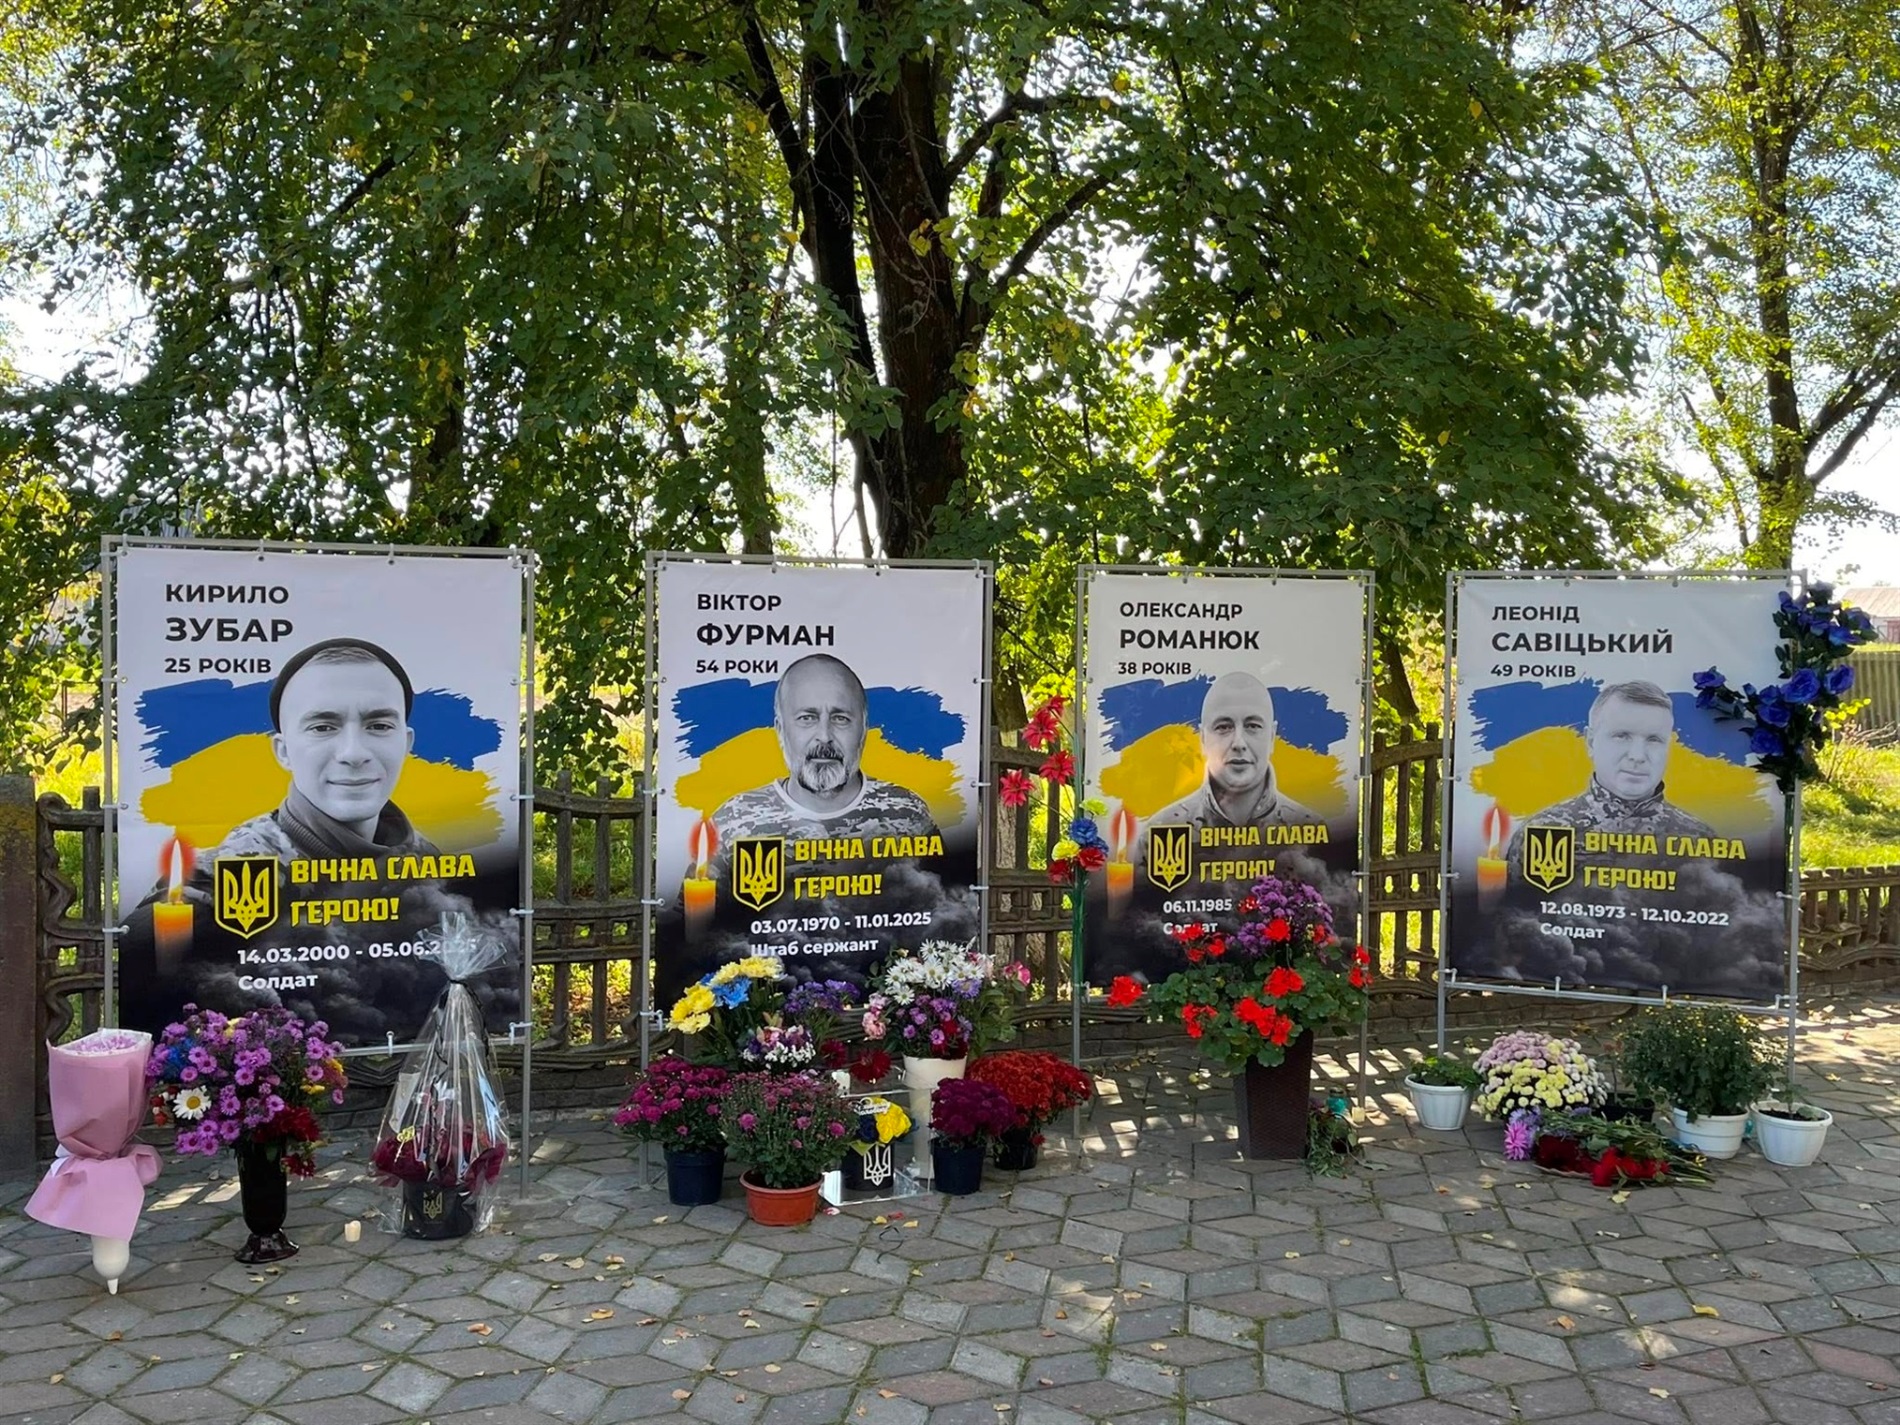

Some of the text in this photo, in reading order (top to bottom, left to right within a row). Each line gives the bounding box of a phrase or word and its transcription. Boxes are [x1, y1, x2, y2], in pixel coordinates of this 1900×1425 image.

[165, 583, 288, 602] КИРИЛО
[697, 593, 781, 610] ВІКТОР
[1120, 602, 1242, 619] ОЛЕКСАНДР
[1492, 605, 1579, 622] ЛЕОНІД
[165, 617, 293, 641] ЗУБАР
[697, 622, 834, 645] ФУРМАН
[1120, 629, 1259, 649] РОМАНЮК
[1492, 628, 1673, 654] САВІЦЬКИЙ
[165, 657, 271, 673] 25 РОКІВ
[696, 659, 778, 673] 54 РОКИ
[1118, 662, 1191, 674] 38 РОКІВ
[1491, 664, 1576, 678] 49 РОКІВ
[1200, 824, 1328, 846] ВІЧНА СЛАВА
[1585, 830, 1746, 858] ВІЧНА СЛАВА
[795, 835, 943, 859] ВІЧНА СЛАВА
[291, 853, 476, 882] ВІЧНА СЛАВА
[1584, 865, 1676, 890] ГЕРОЮ!
[794, 873, 882, 899] ГЕРОЮ!
[290, 897, 400, 926] ГЕРОЮ!
[1163, 898, 1232, 914] 06.11.1985
[1540, 901, 1626, 918] 12.08.1973
[1642, 907, 1729, 925] 12.10.2022
[751, 915, 840, 933] 03.07.1970
[855, 911, 931, 928] 11.01.2025
[1163, 920, 1217, 935] Соат
[1540, 922, 1605, 939] Солдат
[238, 944, 349, 964] 14.03.2000
[368, 938, 477, 958] 05.06.225
[751, 939, 878, 957] Штаб сержант
[238, 973, 318, 990] Солдат
